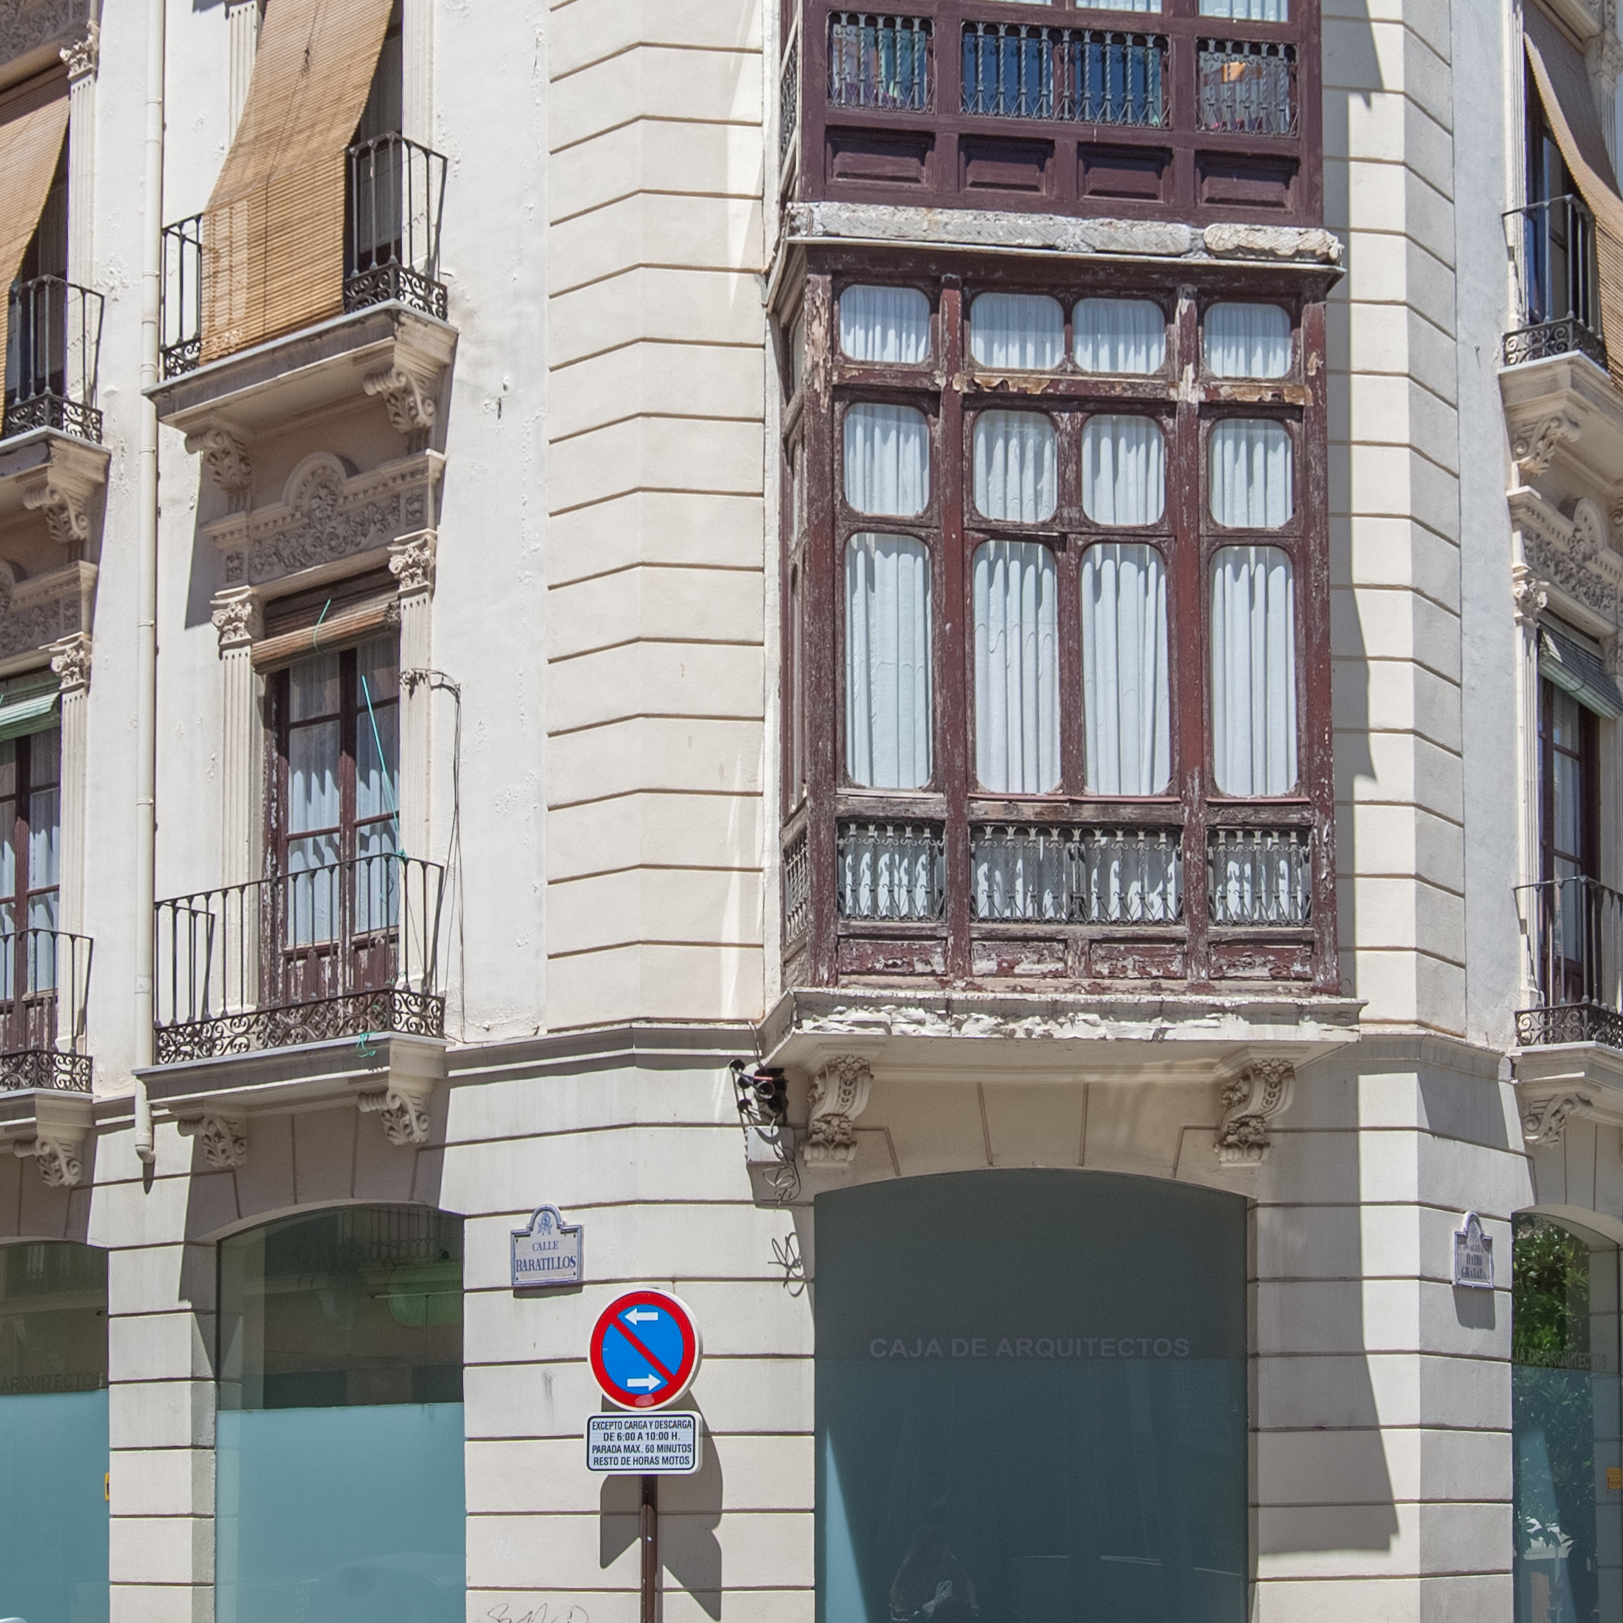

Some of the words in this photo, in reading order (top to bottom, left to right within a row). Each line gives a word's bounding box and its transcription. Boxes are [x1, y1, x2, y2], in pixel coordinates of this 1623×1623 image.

[532, 1241, 559, 1252] CALLE
[516, 1255, 577, 1273] BARATILLOS
[869, 1338, 944, 1358] CAJA
[951, 1338, 987, 1357] DE
[995, 1337, 1191, 1359] ARQUITECTOS
[592, 1421, 623, 1430] EXCEPTO
[624, 1421, 648, 1430] CARGA
[648, 1421, 654, 1429] Y
[654, 1420, 692, 1429] DESCARGA
[603, 1432, 615, 1441] DE
[617, 1432, 636, 1441] 6:00
[637, 1432, 643, 1441] A
[645, 1432, 669, 1441] 10:00
[671, 1431, 680, 1441] H.
[592, 1445, 622, 1454] PARADA
[623, 1444, 643, 1454] MAX.
[645, 1444, 655, 1453] 60
[656, 1444, 692, 1453] MINUTOS
[593, 1456, 619, 1466] RESTO
[620, 1456, 632, 1465] DE
[632, 1456, 660, 1465] HORAS
[661, 1456, 690, 1465] MOTOS
